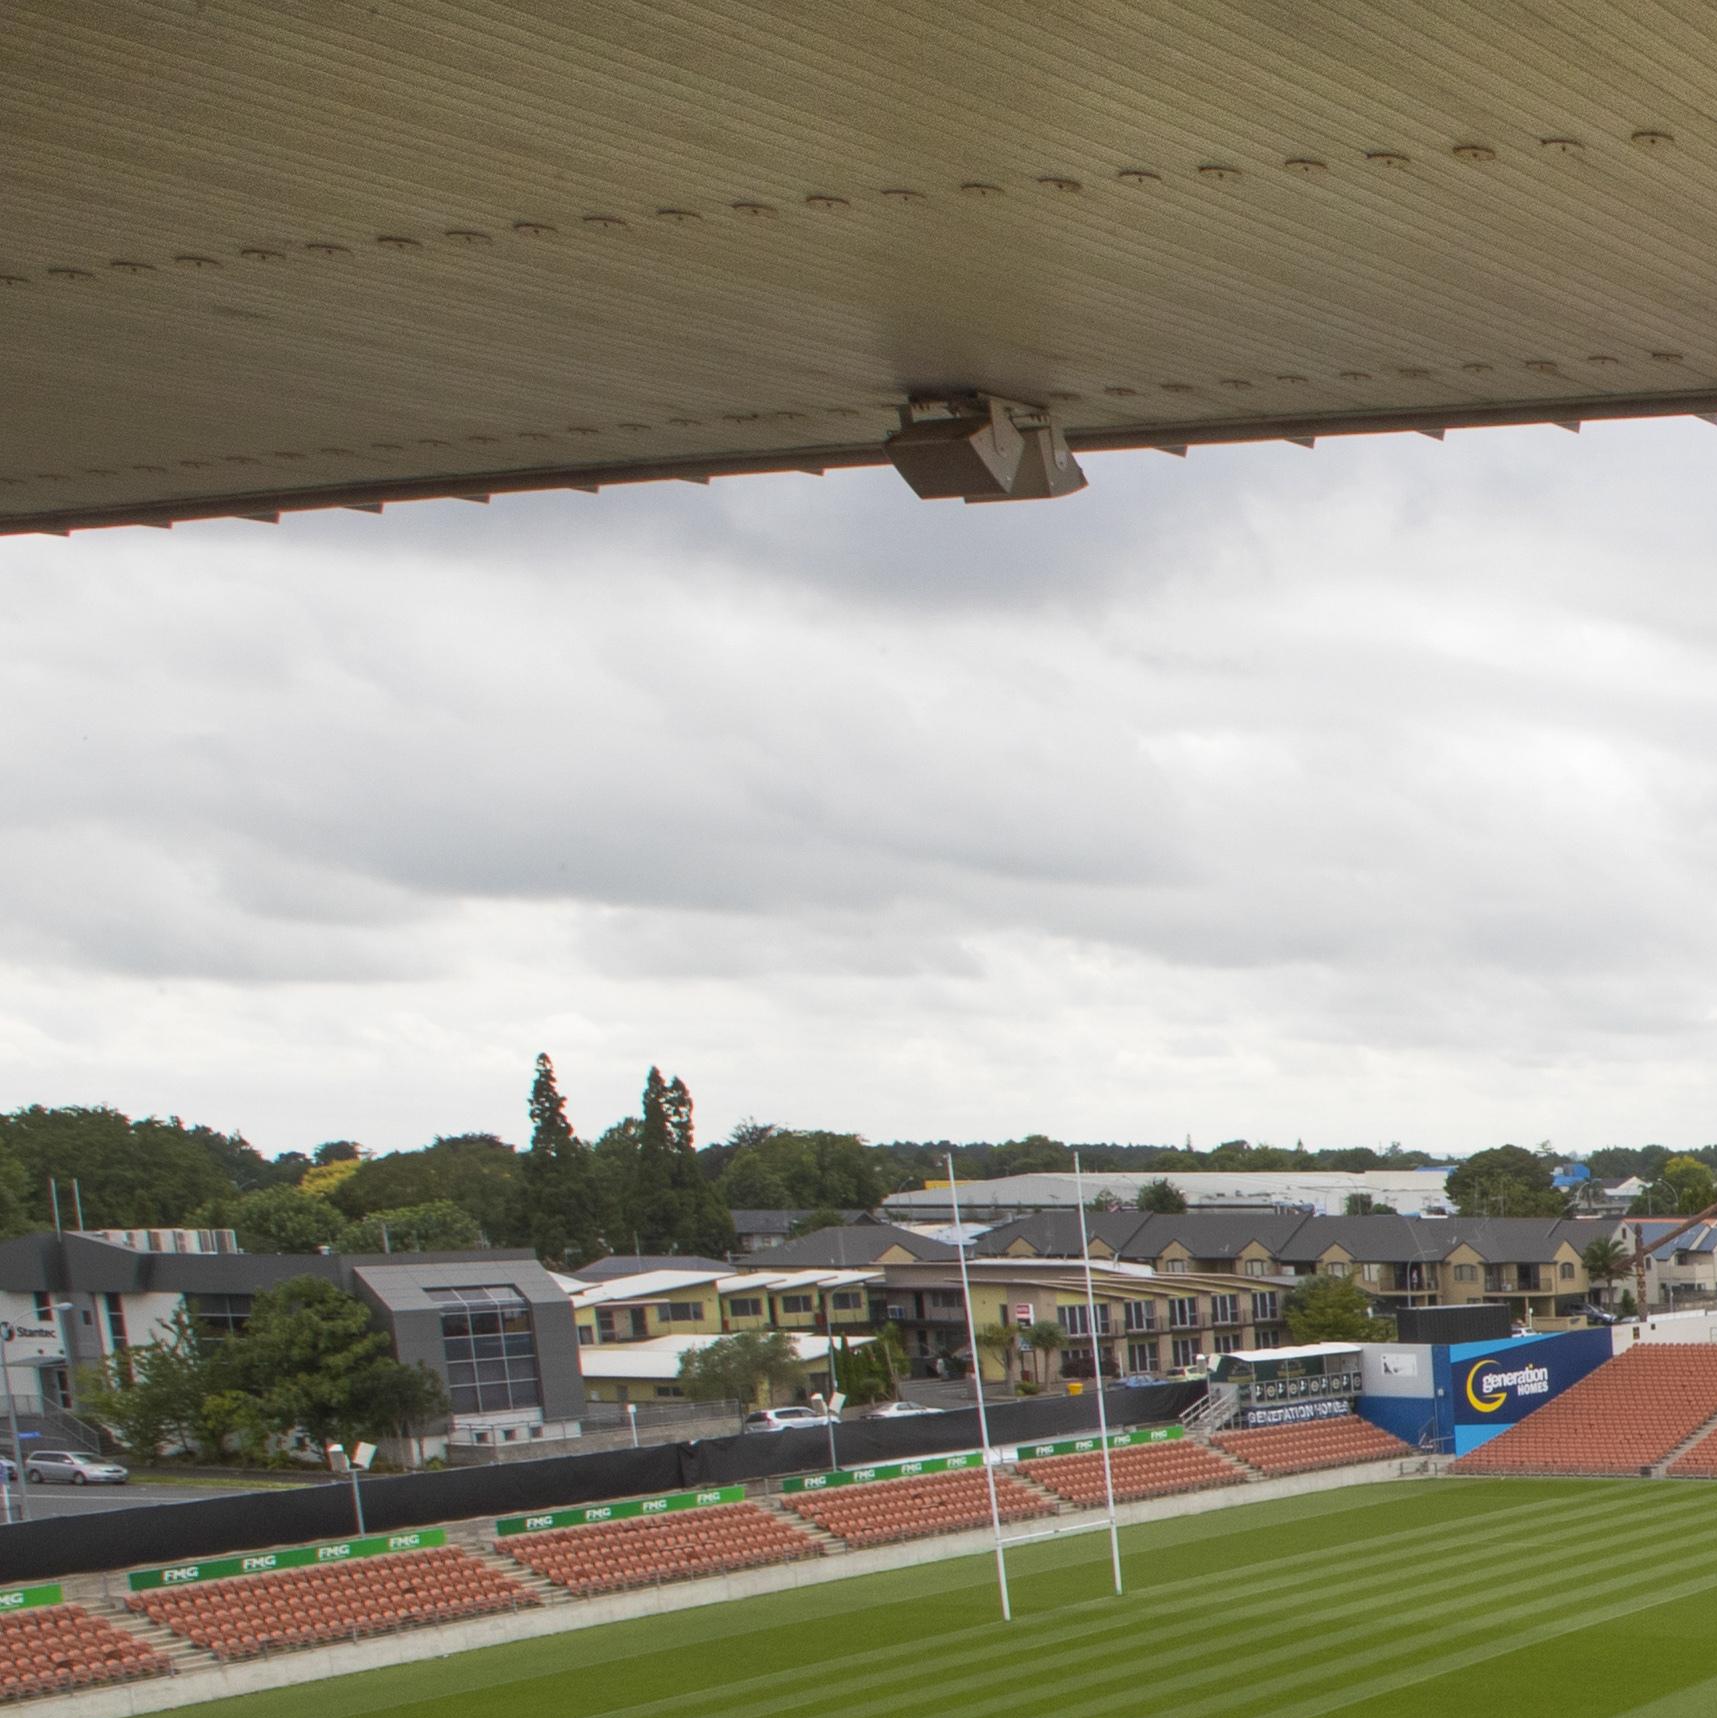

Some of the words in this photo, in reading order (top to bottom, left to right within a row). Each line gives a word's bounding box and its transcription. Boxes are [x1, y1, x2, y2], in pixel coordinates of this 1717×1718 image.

[16, 1326, 57, 1338] Stantec
[1482, 1363, 1549, 1393] generation
[1517, 1381, 1549, 1396] HOMES
[1114, 1435, 1131, 1445] FMG
[1151, 1430, 1168, 1440] FMG
[1036, 1445, 1054, 1456] FMG
[1075, 1440, 1093, 1450] FMG
[947, 1456, 967, 1467] FMG
[901, 1463, 922, 1473] FMG
[853, 1469, 875, 1480] FMG
[804, 1475, 827, 1487] FMG
[696, 1491, 720, 1503] FMG
[641, 1499, 667, 1511] FMG
[585, 1507, 612, 1520] FMG
[526, 1516, 553, 1528] FMG
[389, 1534, 420, 1548] FMG
[317, 1544, 350, 1558] FMG
[243, 1555, 276, 1569] FMG
[163, 1566, 199, 1580] FMG
